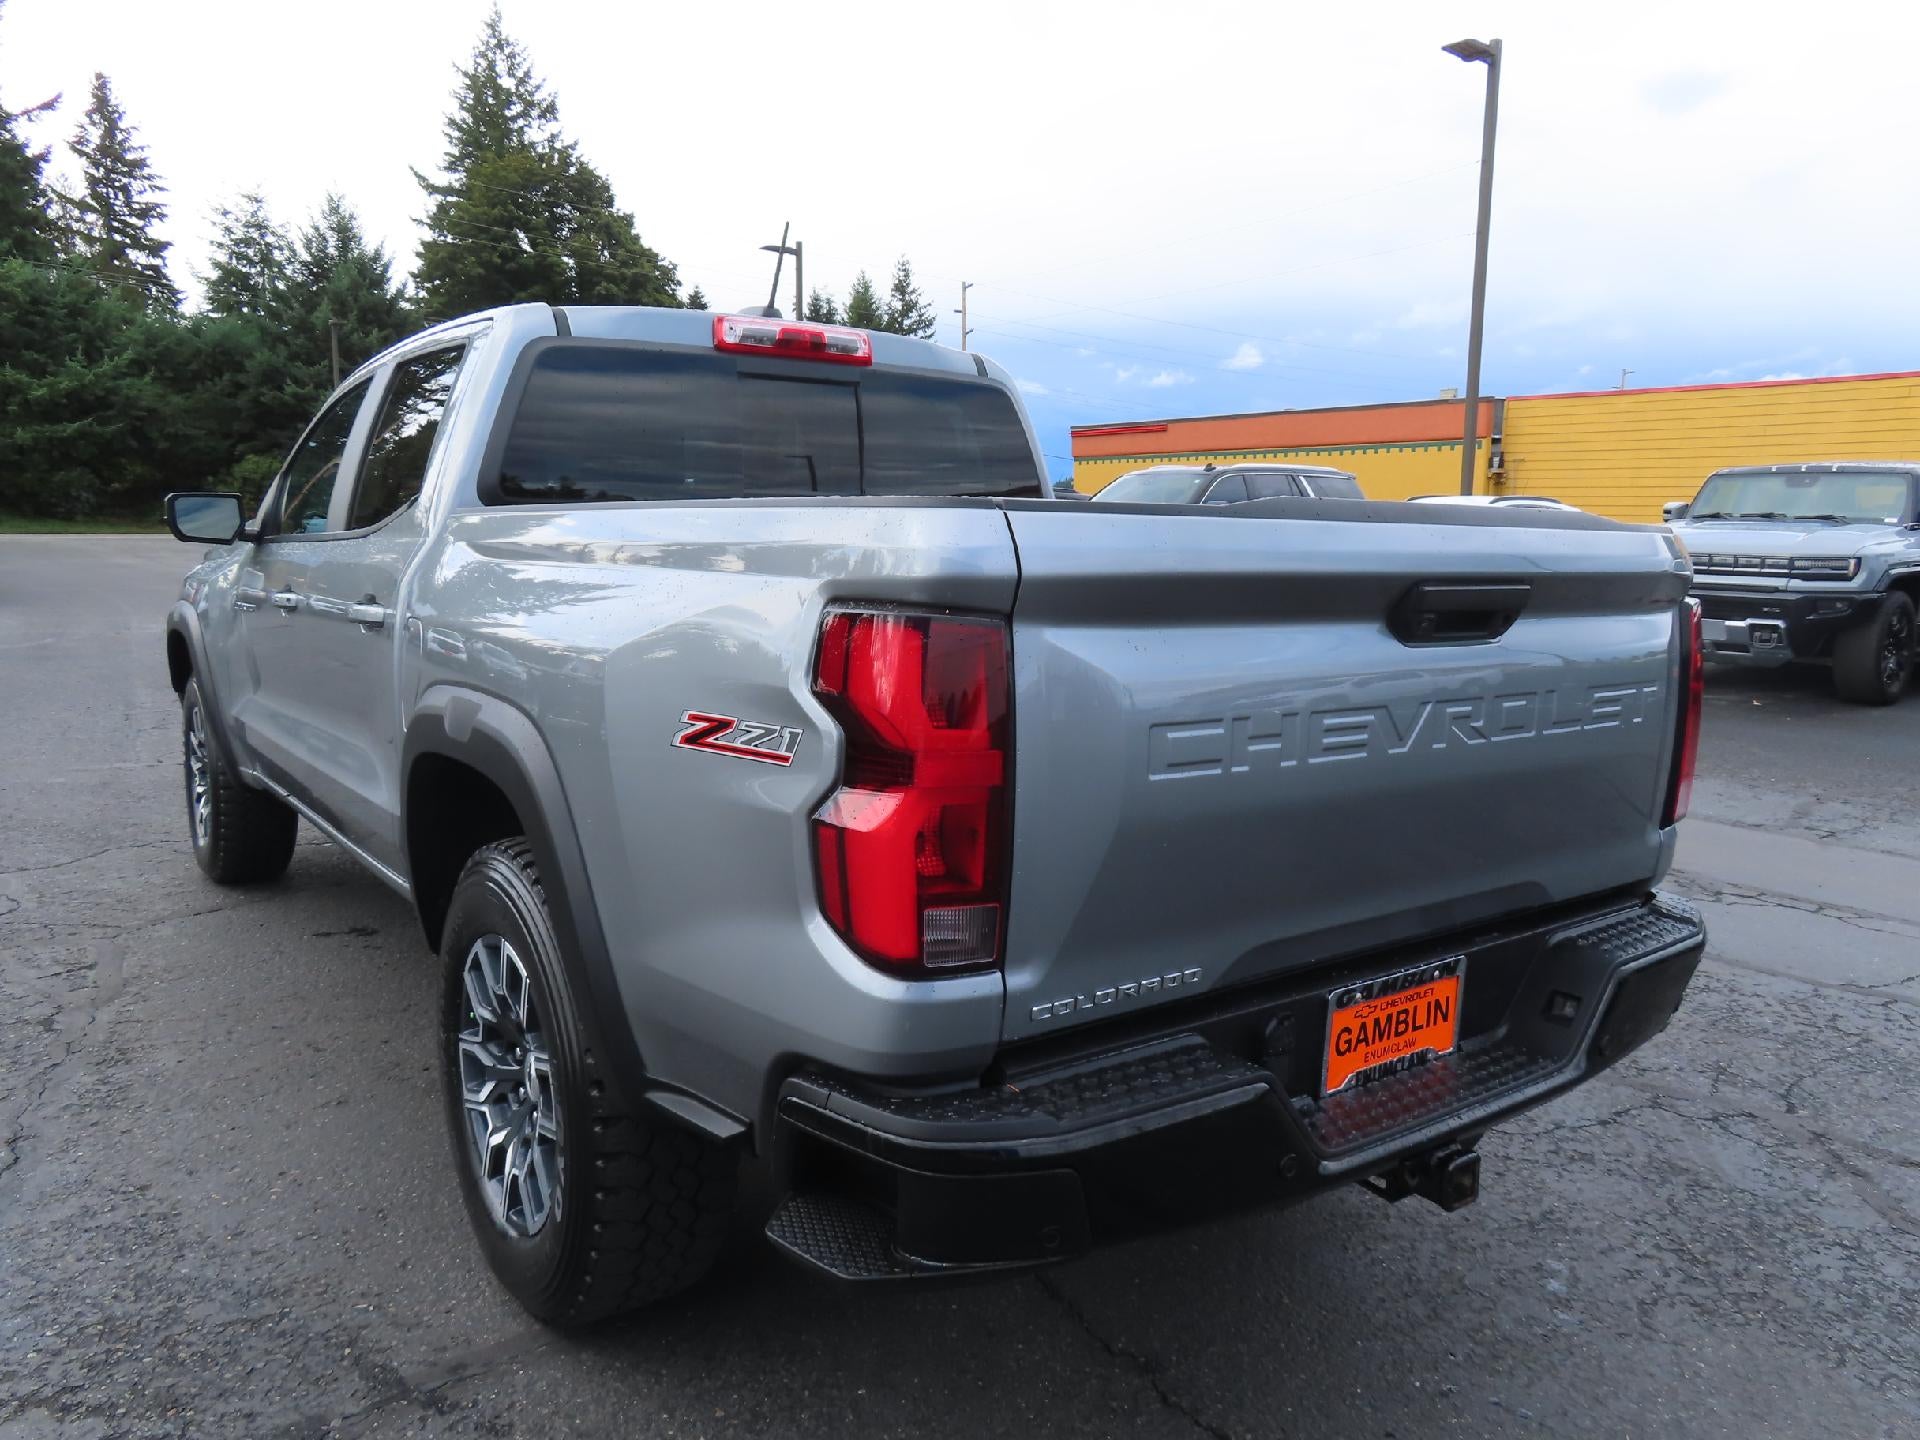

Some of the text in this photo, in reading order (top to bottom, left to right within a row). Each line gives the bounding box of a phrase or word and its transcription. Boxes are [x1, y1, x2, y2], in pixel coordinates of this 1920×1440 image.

[671, 710, 804, 767] Z71
[1147, 681, 1658, 780] CHEVROLET
[1030, 967, 1202, 1022] COLORADO
[1380, 988, 1434, 1011] CHEVROLET
[1335, 996, 1450, 1057] GAMBLIN
[1364, 1037, 1417, 1063] ENUMCLAW
